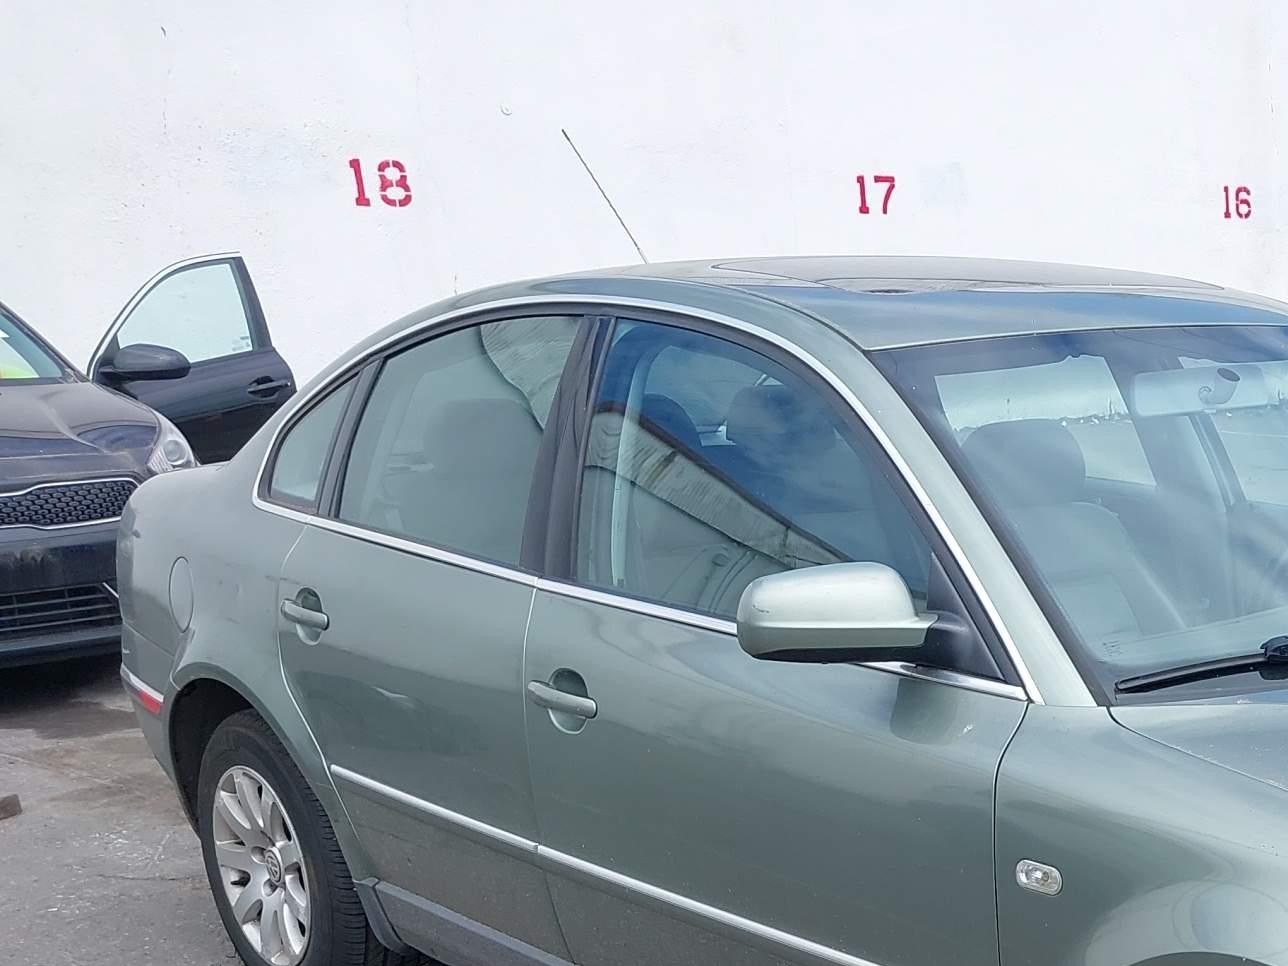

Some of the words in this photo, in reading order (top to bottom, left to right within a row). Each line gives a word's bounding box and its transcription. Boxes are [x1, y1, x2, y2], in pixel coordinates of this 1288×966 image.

[348, 158, 413, 208] 18
[855, 174, 897, 215] 17
[1223, 185, 1252, 219] 16
